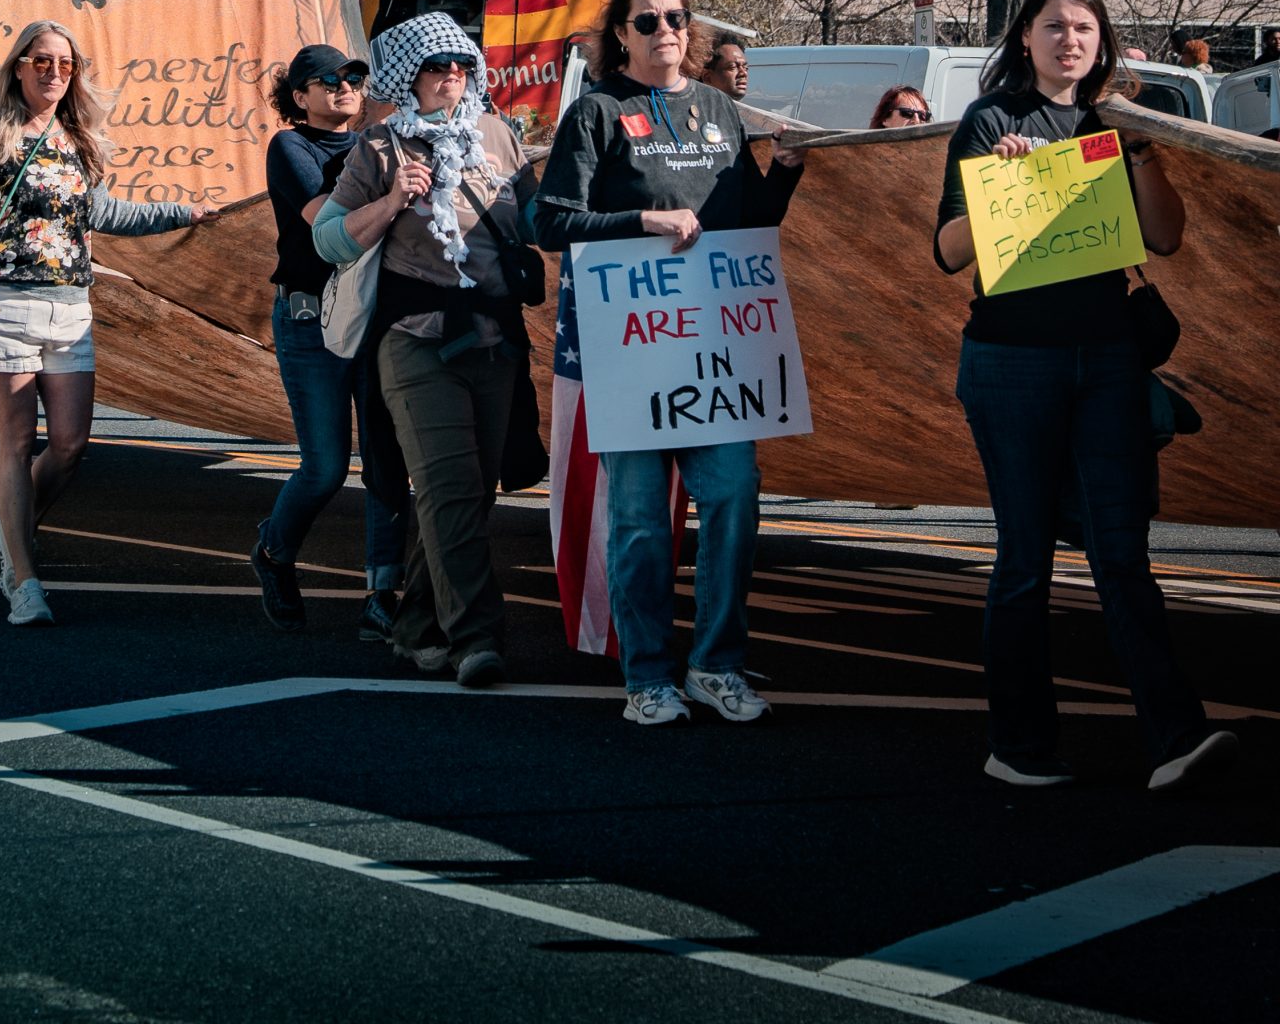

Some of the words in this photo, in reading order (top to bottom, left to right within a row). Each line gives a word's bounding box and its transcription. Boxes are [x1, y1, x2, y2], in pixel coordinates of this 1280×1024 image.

[485, 53, 560, 90] ornia
[104, 87, 269, 144] uility,
[108, 145, 235, 172] ence,
[633, 142, 677, 156] radical
[702, 141, 732, 154] scum
[666, 156, 714, 171] (apparently)
[978, 148, 1075, 196] FIGHT
[989, 176, 1103, 221] AGAINST
[994, 216, 1121, 268] FASCISM
[587, 257, 686, 303] THE
[709, 252, 776, 289] FILES
[622, 308, 703, 347] ARE
[720, 298, 779, 337] NOT
[696, 347, 734, 380] IN
[650, 353, 790, 430] IRAN!
